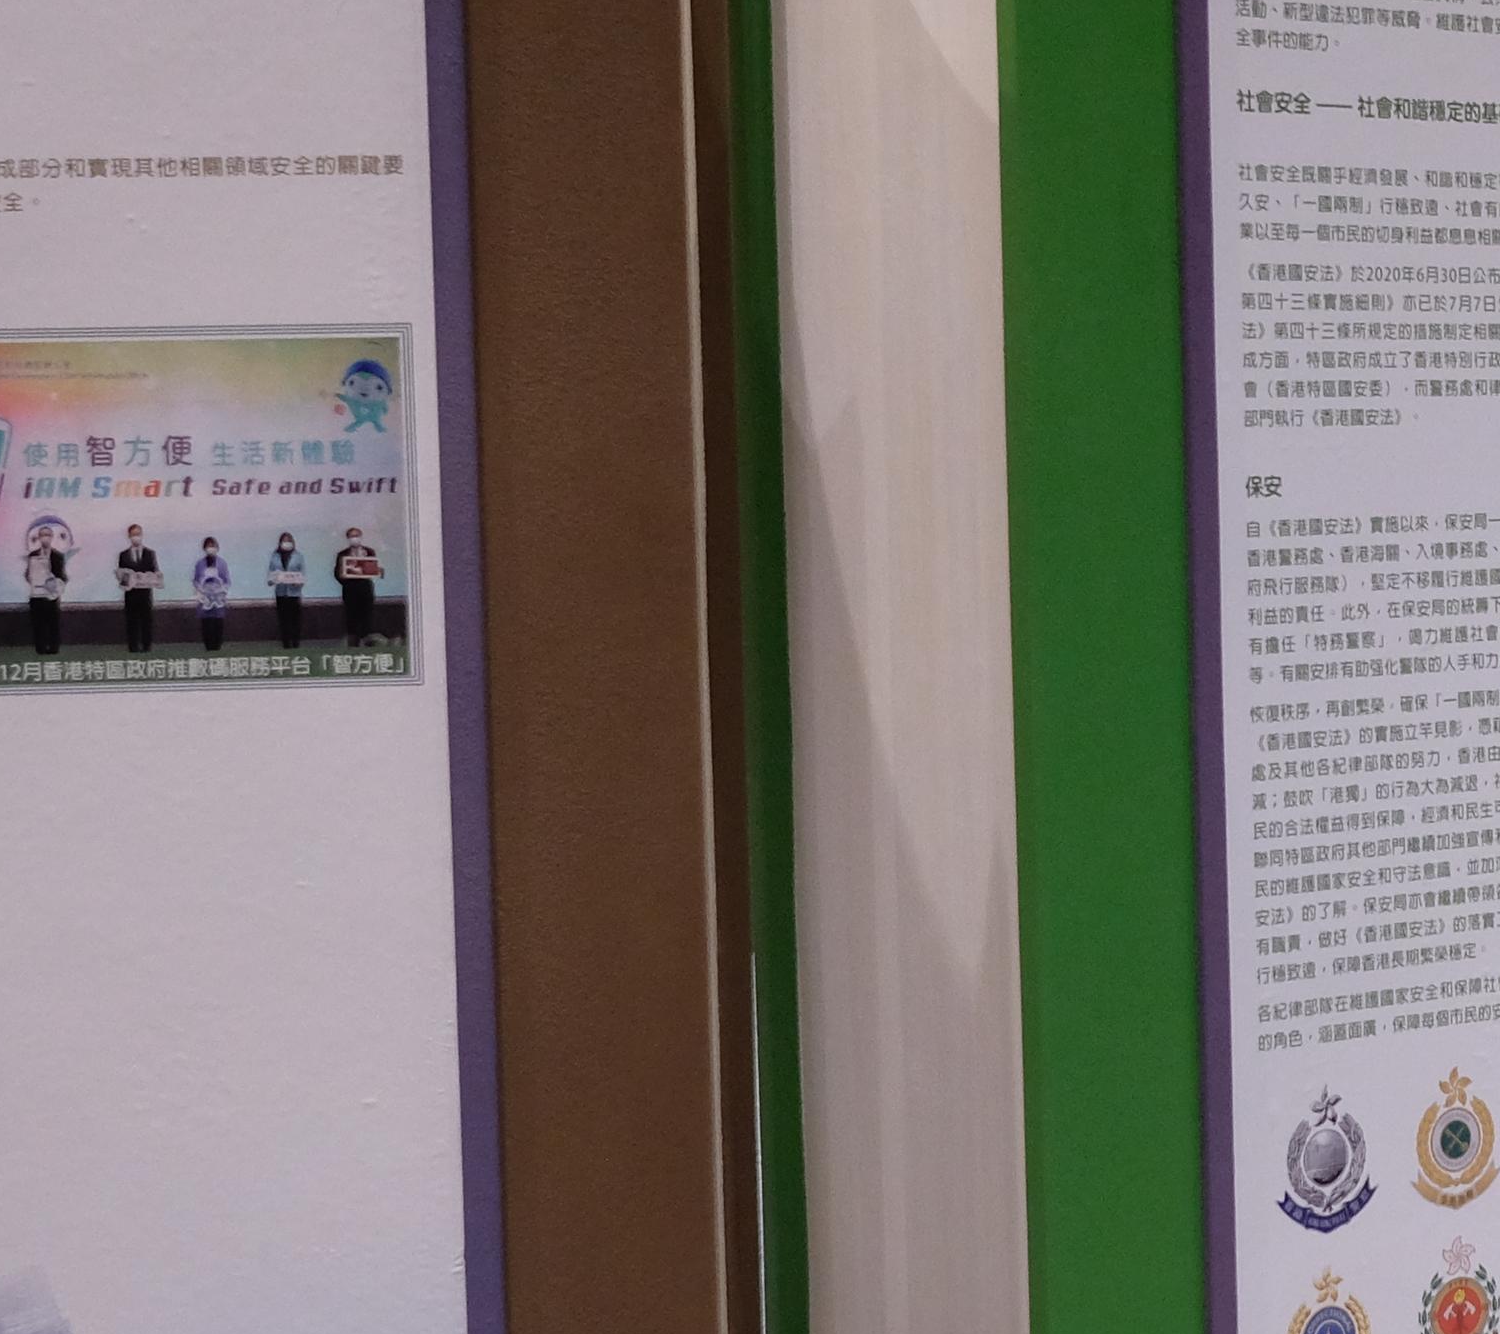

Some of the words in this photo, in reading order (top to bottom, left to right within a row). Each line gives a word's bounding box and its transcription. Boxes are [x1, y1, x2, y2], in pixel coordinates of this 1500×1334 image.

[22, 435, 193, 468] 使用智方便
[91, 475, 193, 499] Smart
[212, 478, 272, 496] Safe
[278, 477, 323, 496] and
[329, 475, 399, 495] Swift
[1245, 475, 1282, 498] 保安
